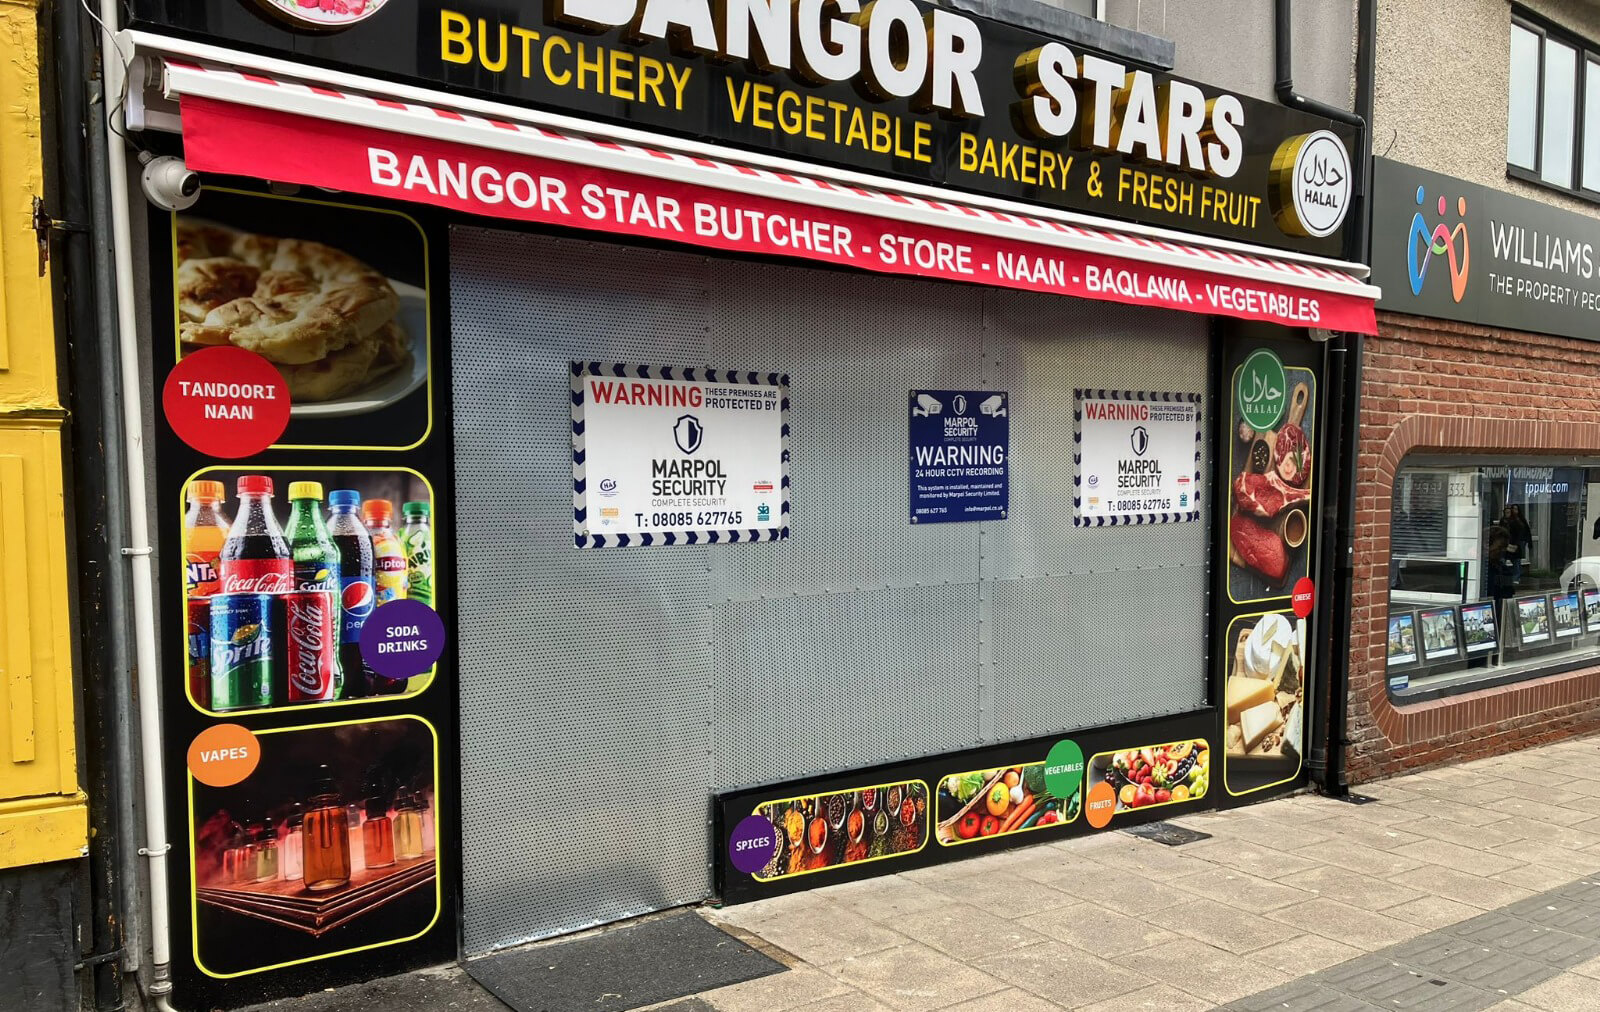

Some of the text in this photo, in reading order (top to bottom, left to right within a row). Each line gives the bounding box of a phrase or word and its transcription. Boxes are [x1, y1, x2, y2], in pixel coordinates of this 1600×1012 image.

[1033, 42, 1244, 178] STARS
[440, 9, 1261, 228] BUTCHERY VEGETABLE BAKERY & FRESH FRUIT
[1304, 153, 1343, 186] حلال
[1304, 188, 1338, 208] HALAL
[367, 146, 570, 215] BANGOR
[581, 184, 684, 232] STAR
[694, 202, 855, 257] BUTCHER
[879, 234, 973, 275] STORE
[996, 251, 1066, 287] NAAN
[1085, 266, 1192, 304] BAQLAWA
[1206, 285, 1320, 322] VEGETABLES
[1490, 220, 1592, 278] WILLIAMS
[1490, 274, 1513, 295] THE
[1517, 279, 1578, 306] PROPERTY
[179, 381, 275, 400] TANDOORI
[590, 381, 702, 408] WARNING
[705, 388, 728, 396] THESE
[729, 389, 762, 398] PREMISES
[204, 404, 253, 420] NAAN
[706, 399, 776, 410] PROTECTED BY
[1086, 403, 1148, 420] WARNING
[1246, 404, 1278, 414] HALAL
[944, 417, 978, 427] MARPOL
[1150, 413, 1184, 421] PROTECTED
[944, 428, 978, 436] SECURITY
[916, 445, 1004, 466] WARNING
[652, 459, 726, 478] MARPOL
[916, 468, 1004, 477] 24 HOUR CCTV RECORDING
[1118, 460, 1162, 474] MARPOL
[652, 480, 726, 496] SECURITY
[1118, 475, 1162, 488] SECURITY
[1525, 478, 1568, 497] tppuk.com
[652, 498, 726, 507] COMPLETE SECURITY
[1108, 501, 1115, 511] T:
[1117, 500, 1141, 511] 08085
[1143, 499, 1170, 510] 627765
[635, 513, 648, 527] T:
[653, 513, 692, 526] 08085
[697, 511, 742, 525] 627765
[1294, 592, 1312, 601] CHEESE
[386, 626, 419, 638] SODA
[378, 640, 427, 653] DRINKS
[212, 636, 271, 674] Sprite
[200, 746, 248, 763] VAPES
[1044, 762, 1083, 776] VEGETABLES
[1090, 799, 1112, 810] FRUITS
[736, 837, 770, 851] SPICES
